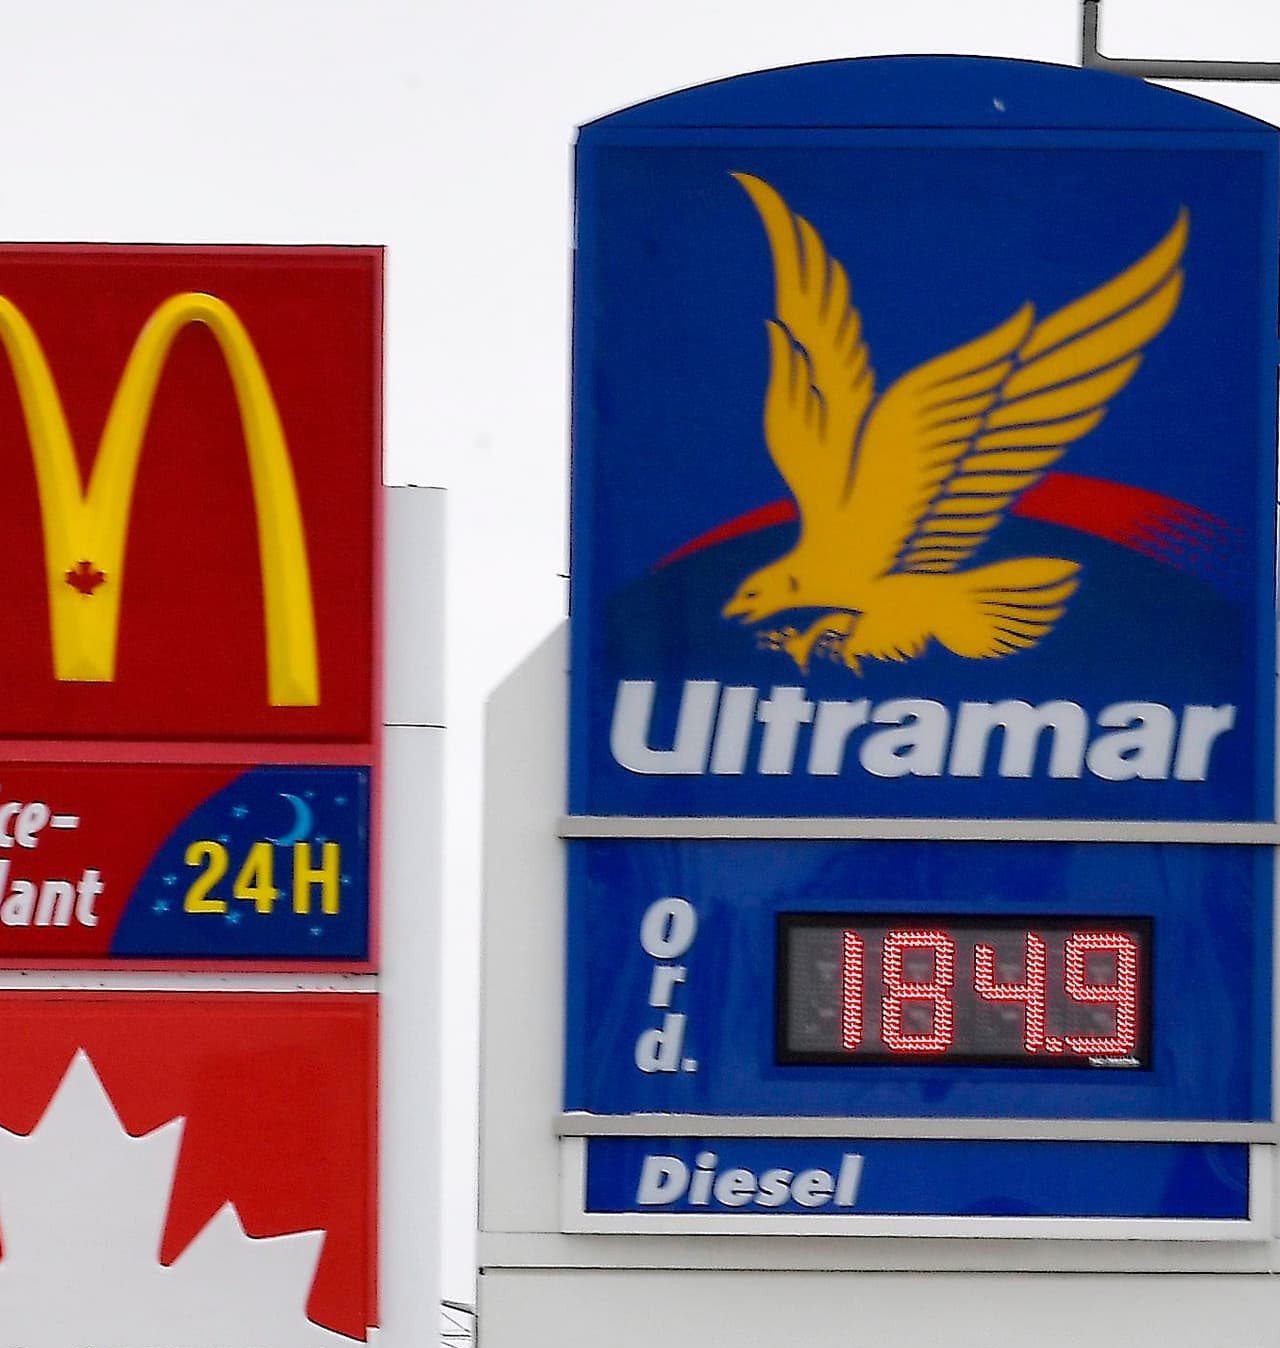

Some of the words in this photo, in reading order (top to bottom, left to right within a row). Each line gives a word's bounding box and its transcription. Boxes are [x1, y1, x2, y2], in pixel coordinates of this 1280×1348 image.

[610, 680, 1236, 782] Ultramar
[840, 930, 1138, 1055] 184.9
[636, 1154, 864, 1208] Diesel
